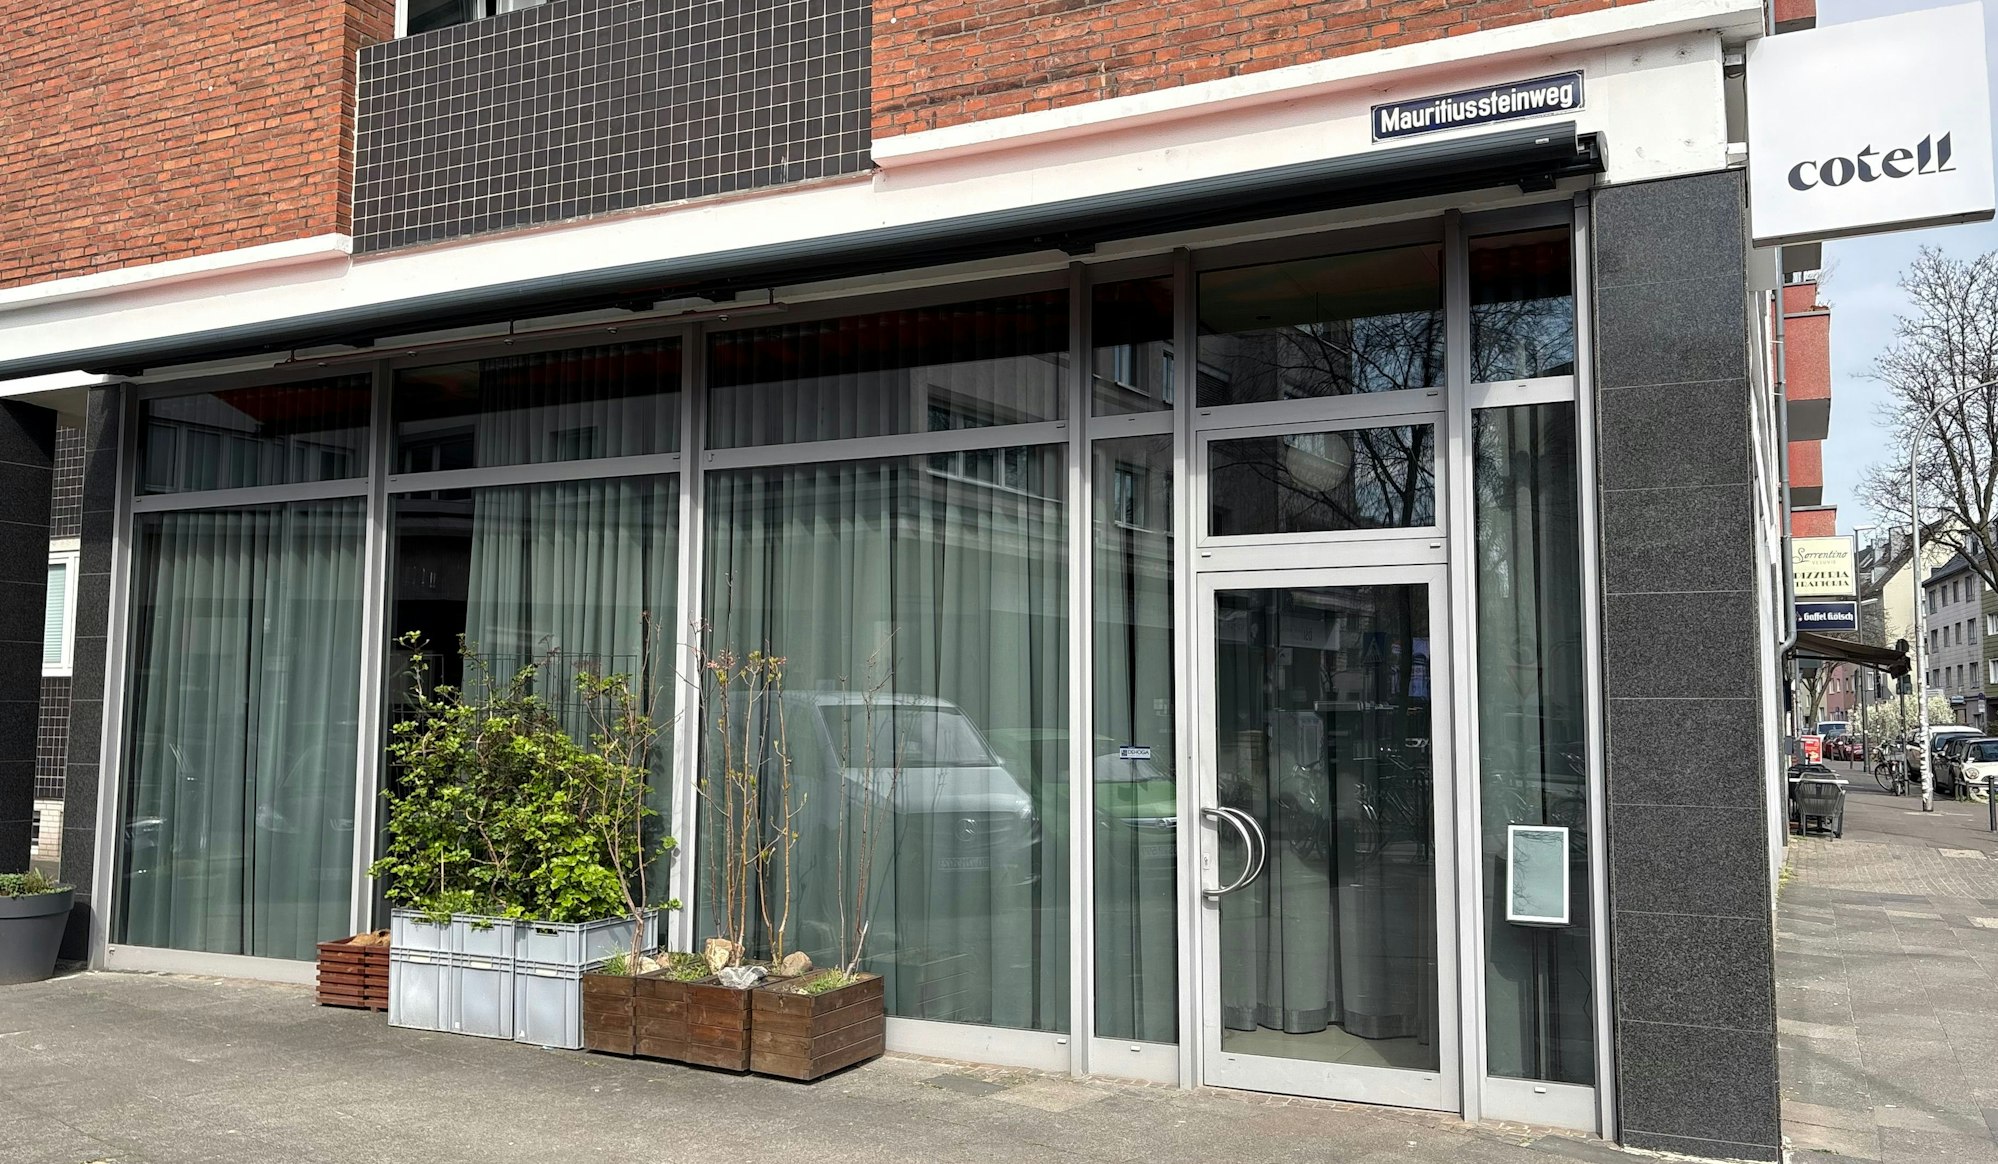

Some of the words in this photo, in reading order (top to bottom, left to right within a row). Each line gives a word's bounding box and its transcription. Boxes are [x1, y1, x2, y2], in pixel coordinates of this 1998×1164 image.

[1381, 82, 1574, 133] Mauritiussteinweg
[1787, 130, 1957, 191] cotell
[1792, 547, 1848, 564] Sorrentino
[1794, 571, 1849, 579] PIZZERIA
[1803, 612, 1827, 621] Gaffel
[1827, 611, 1854, 621] Kölsch
